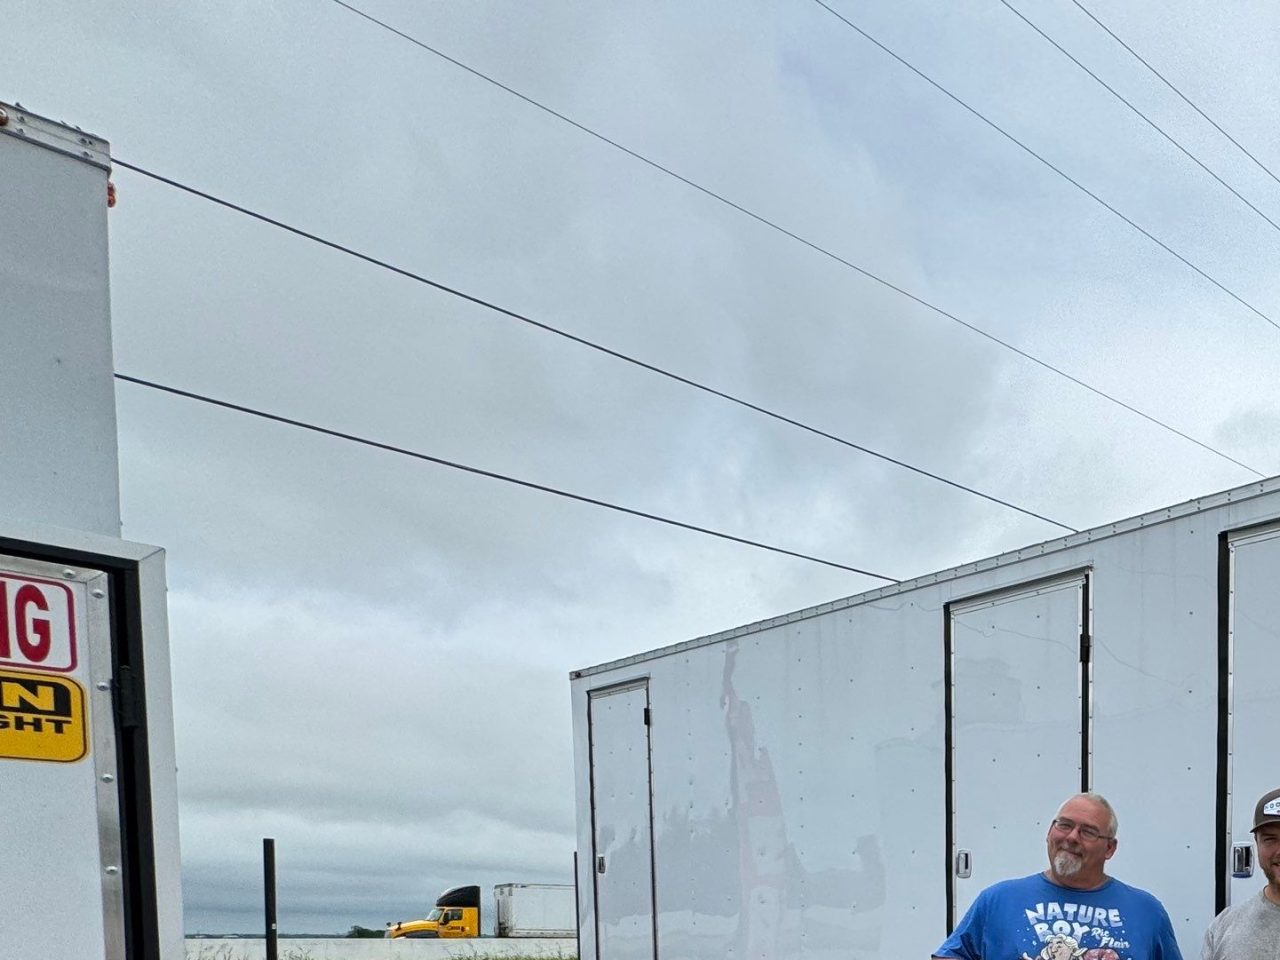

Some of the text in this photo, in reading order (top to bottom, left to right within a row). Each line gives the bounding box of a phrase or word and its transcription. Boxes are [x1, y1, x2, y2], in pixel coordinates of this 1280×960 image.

[1025, 902, 1123, 928] NATURE
[1033, 920, 1090, 945] BOY
[1090, 927, 1110, 940] Ric
[1098, 937, 1131, 949] Flair
